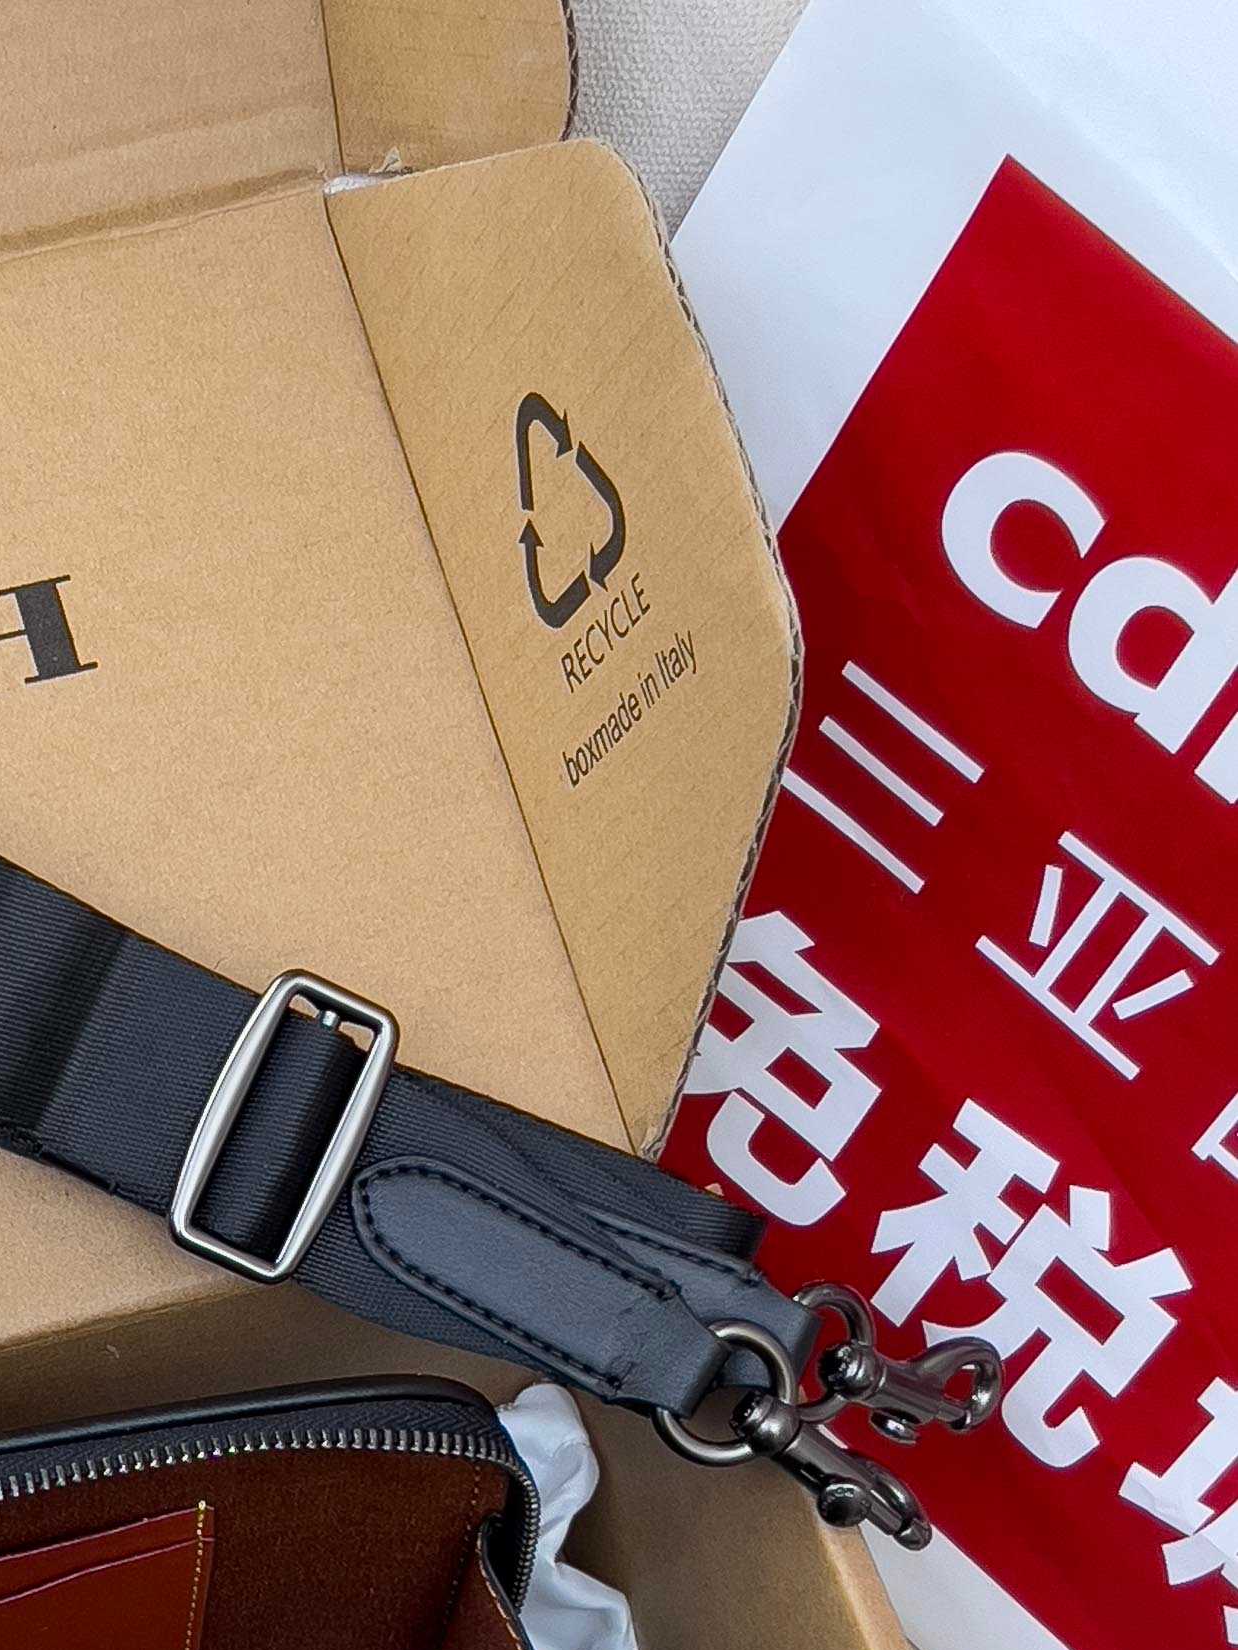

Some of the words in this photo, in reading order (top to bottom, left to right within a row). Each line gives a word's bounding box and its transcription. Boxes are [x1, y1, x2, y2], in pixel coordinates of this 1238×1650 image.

[561, 571, 651, 694] RECYCLE
[562, 691, 643, 788] boxmade
[636, 671, 661, 709] in
[654, 630, 697, 690] Italy
[941, 450, 1238, 804] cd
[780, 660, 1238, 1182] 三亚
